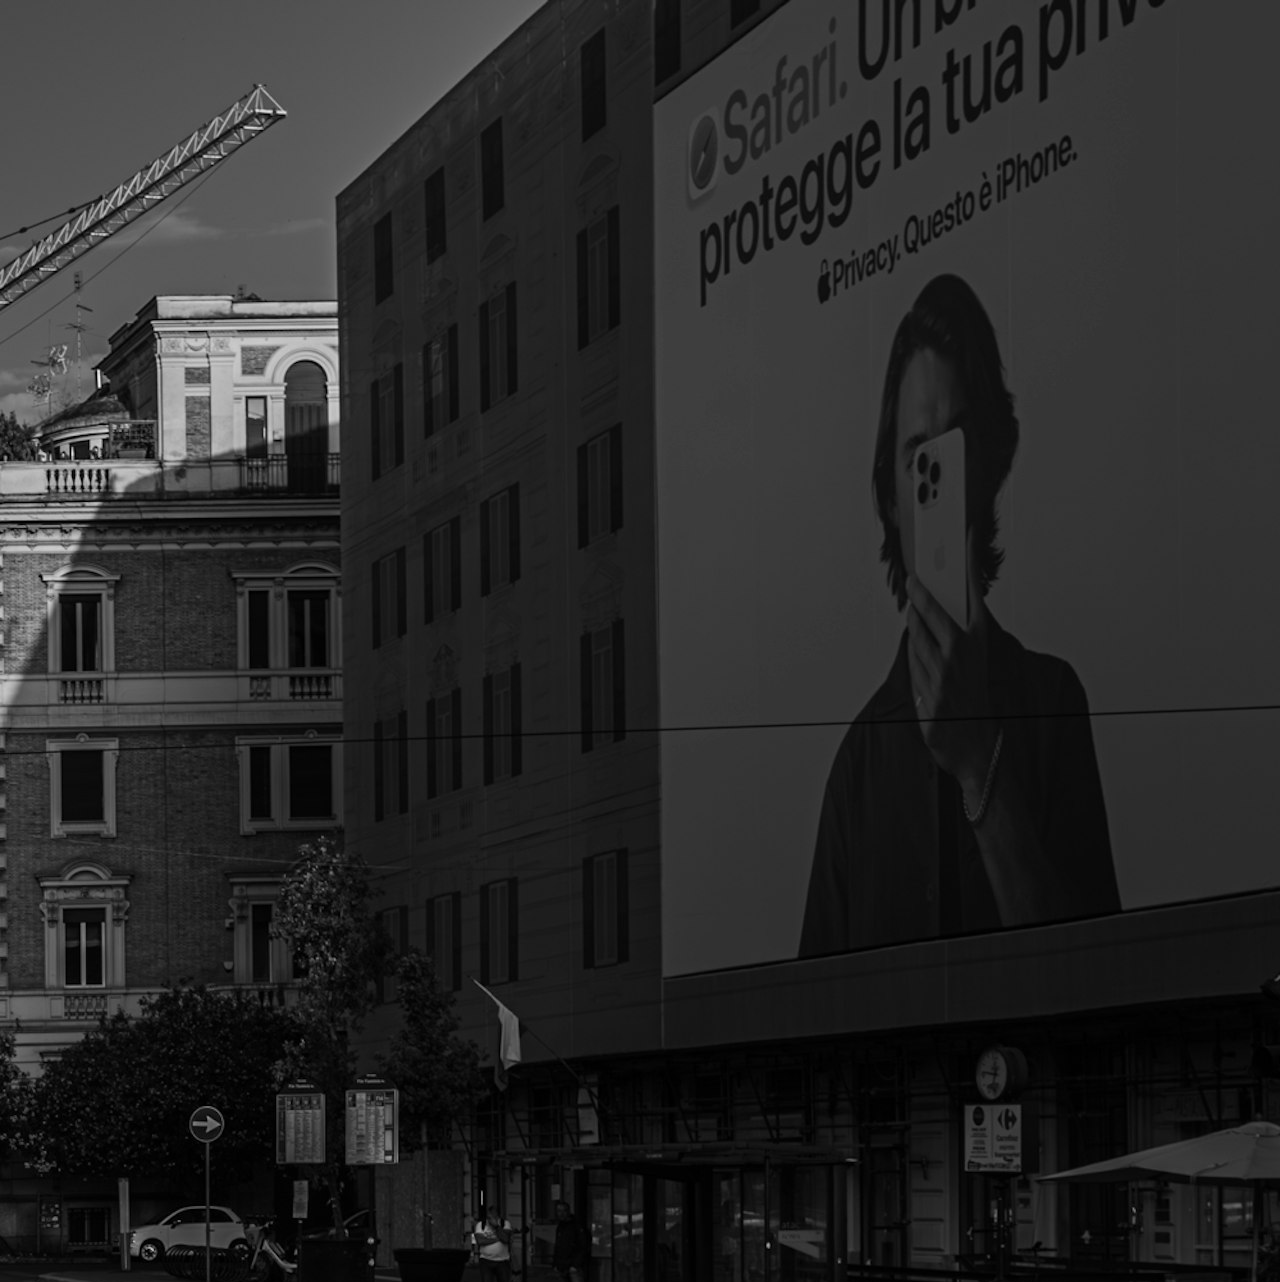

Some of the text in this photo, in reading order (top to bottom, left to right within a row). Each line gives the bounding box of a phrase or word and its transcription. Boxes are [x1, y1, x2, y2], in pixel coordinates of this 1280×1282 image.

[699, 118, 882, 307] protegge
[893, 78, 931, 170] la
[943, 24, 1023, 134] tua
[722, 17, 848, 175] Safari.
[832, 134, 1078, 297] Privacy. Questo è iPhone.
